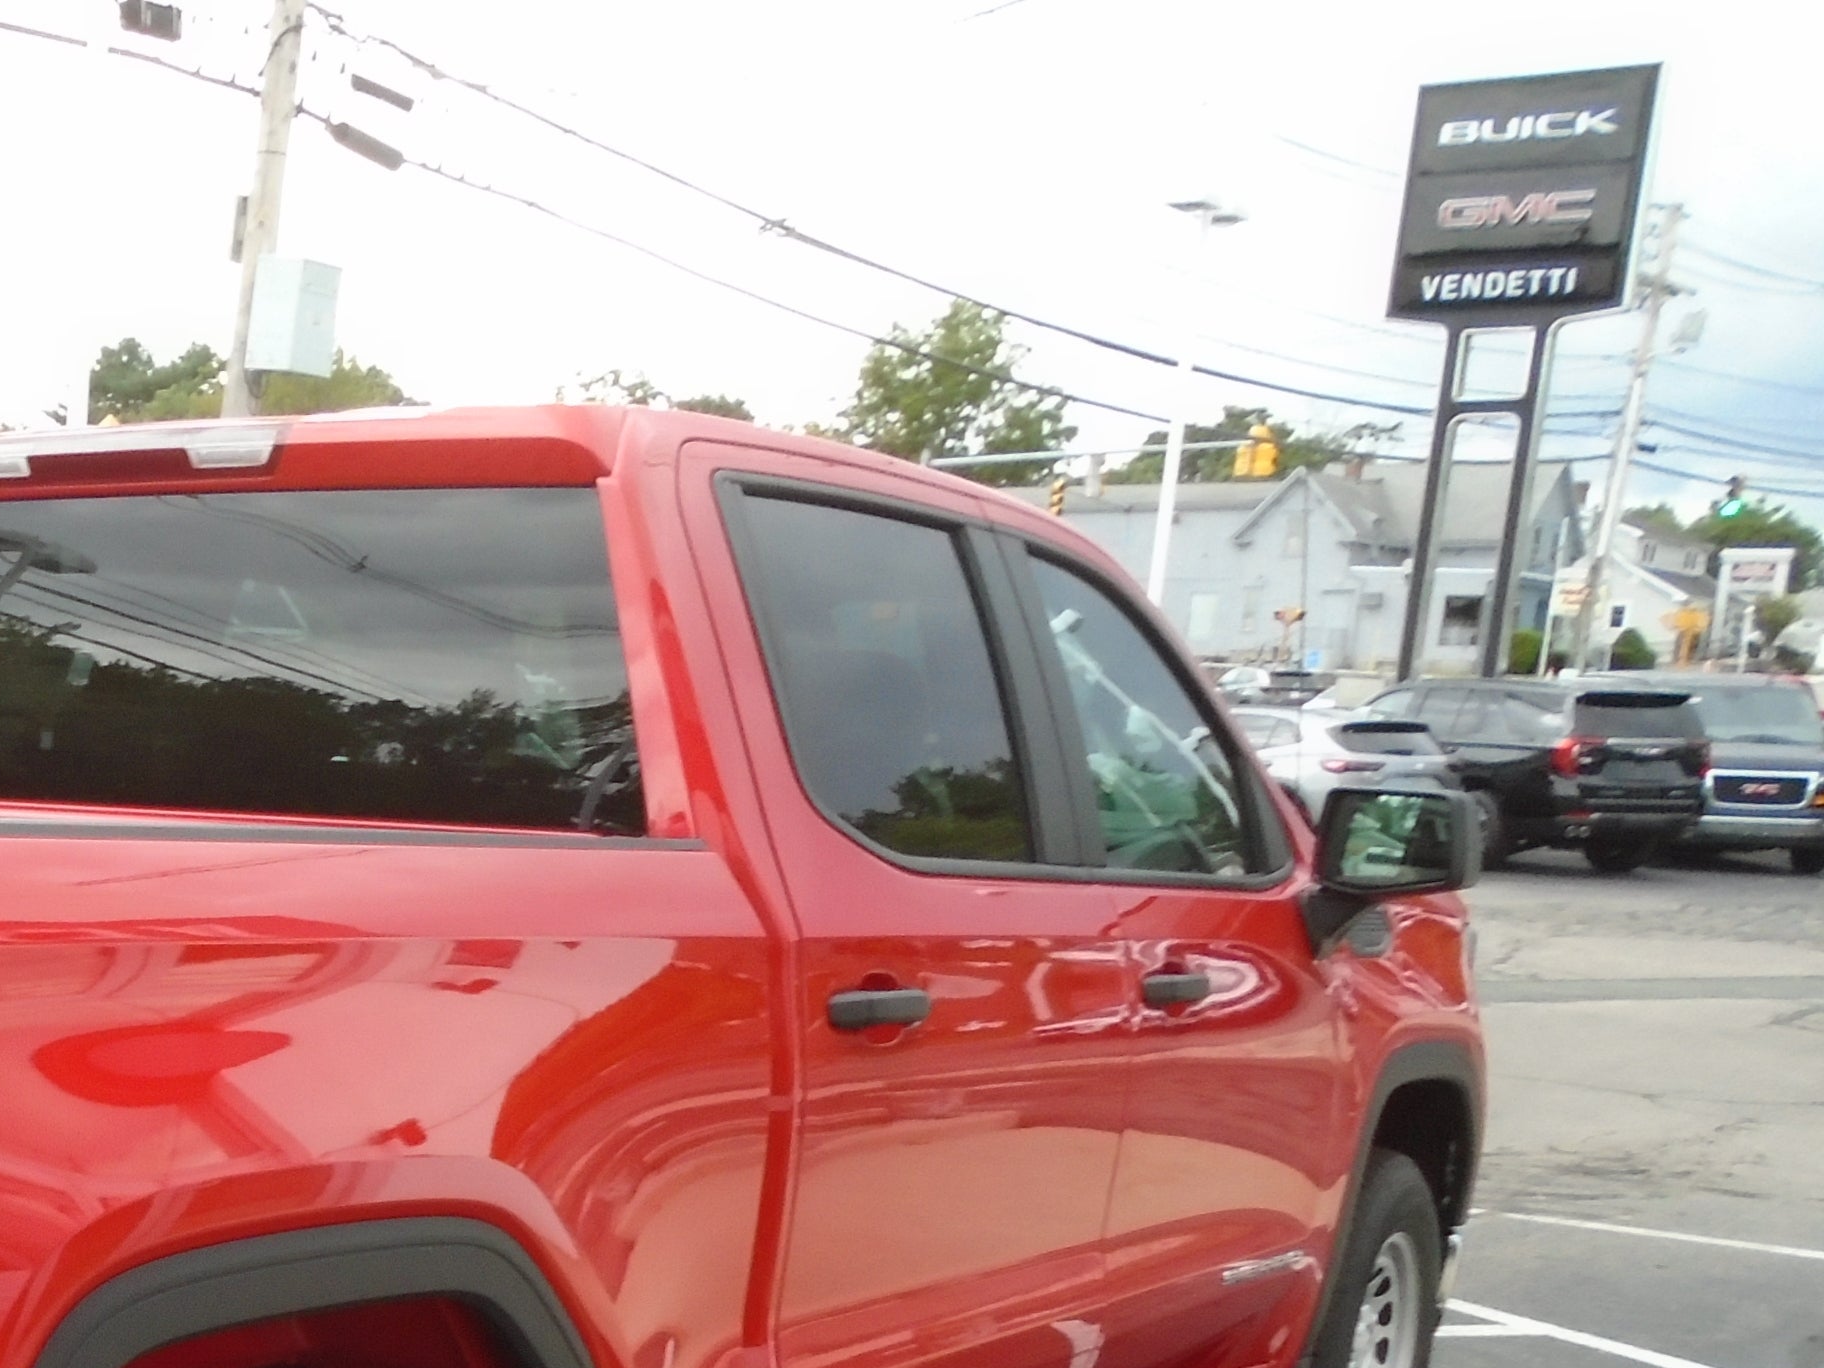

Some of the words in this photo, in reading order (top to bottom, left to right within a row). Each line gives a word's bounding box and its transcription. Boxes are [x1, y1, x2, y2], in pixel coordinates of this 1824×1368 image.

[1438, 107, 1619, 147] BUICK
[1437, 188, 1597, 229] GMC
[1421, 267, 1579, 302] VENDETTI
